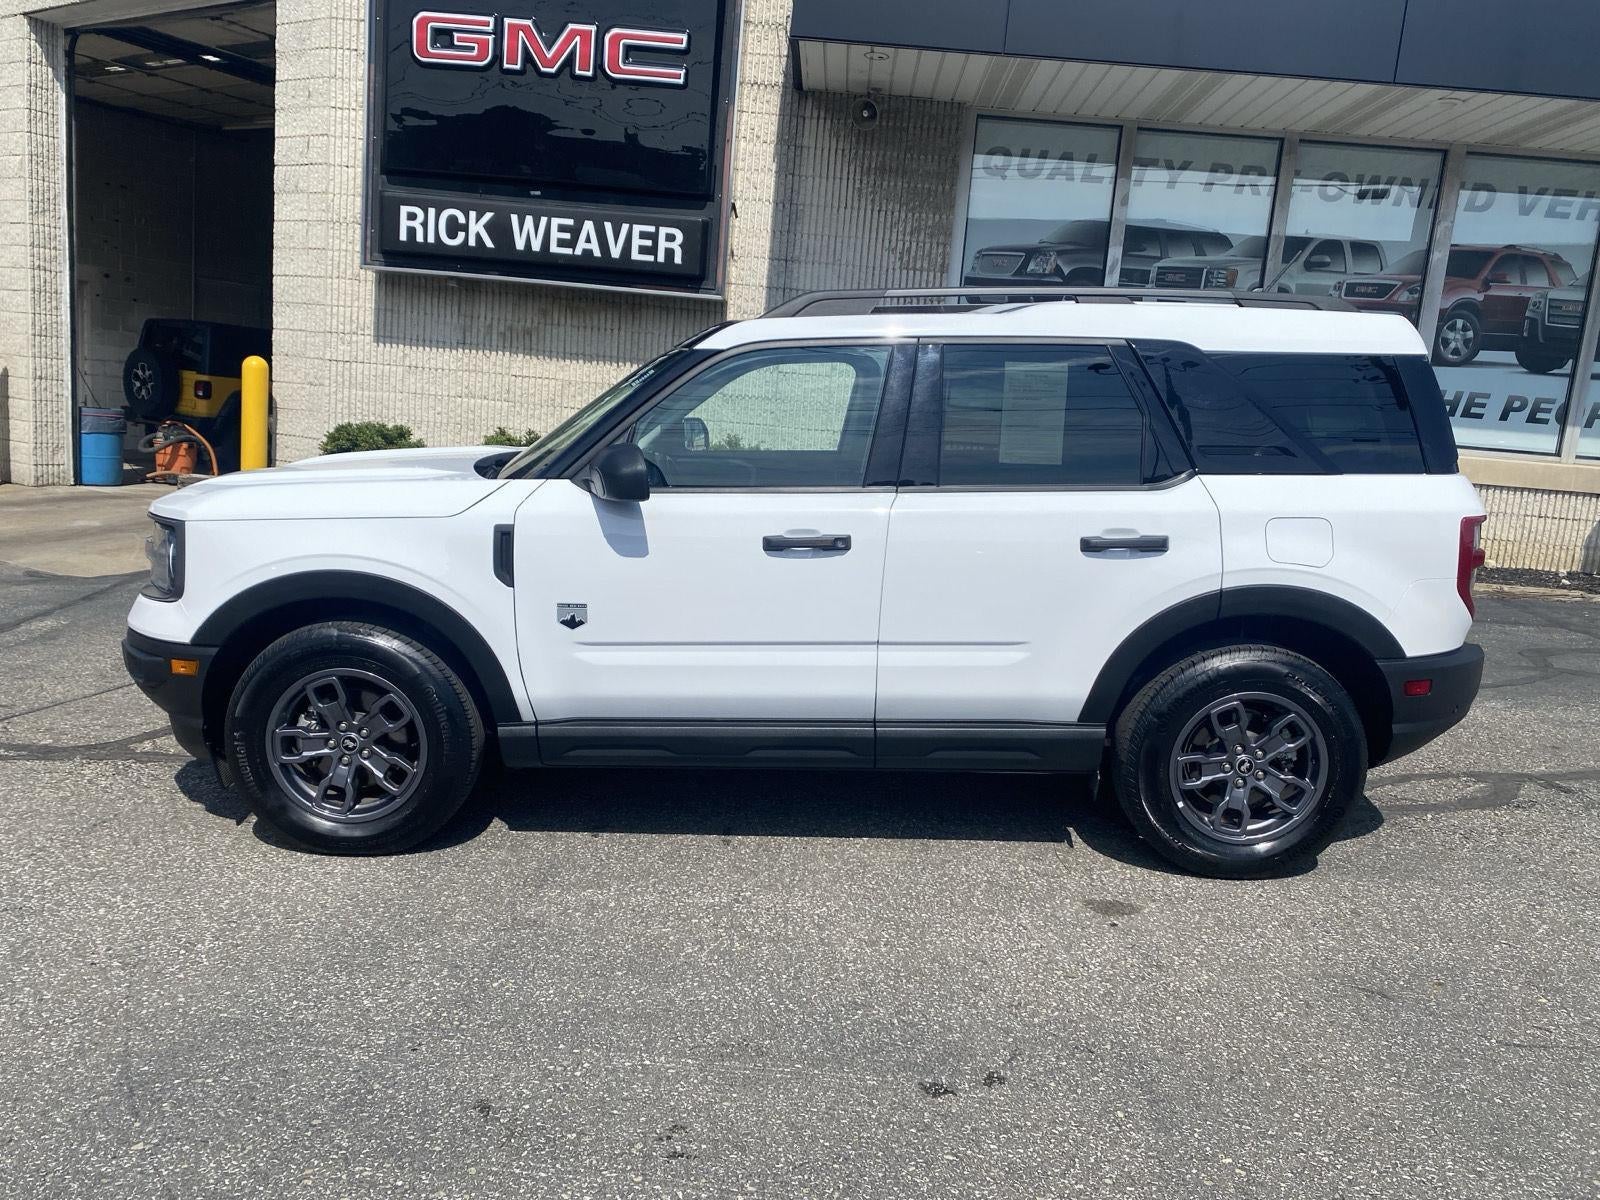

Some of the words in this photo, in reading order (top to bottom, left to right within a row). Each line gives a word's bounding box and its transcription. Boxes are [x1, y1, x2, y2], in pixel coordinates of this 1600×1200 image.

[412, 11, 689, 84] GMC
[981, 145, 1194, 190] QUALTY
[1202, 162, 1497, 213] PR-OWND
[398, 205, 495, 249] RICK
[510, 213, 684, 264] WEAVER
[1440, 389, 1491, 420] HE
